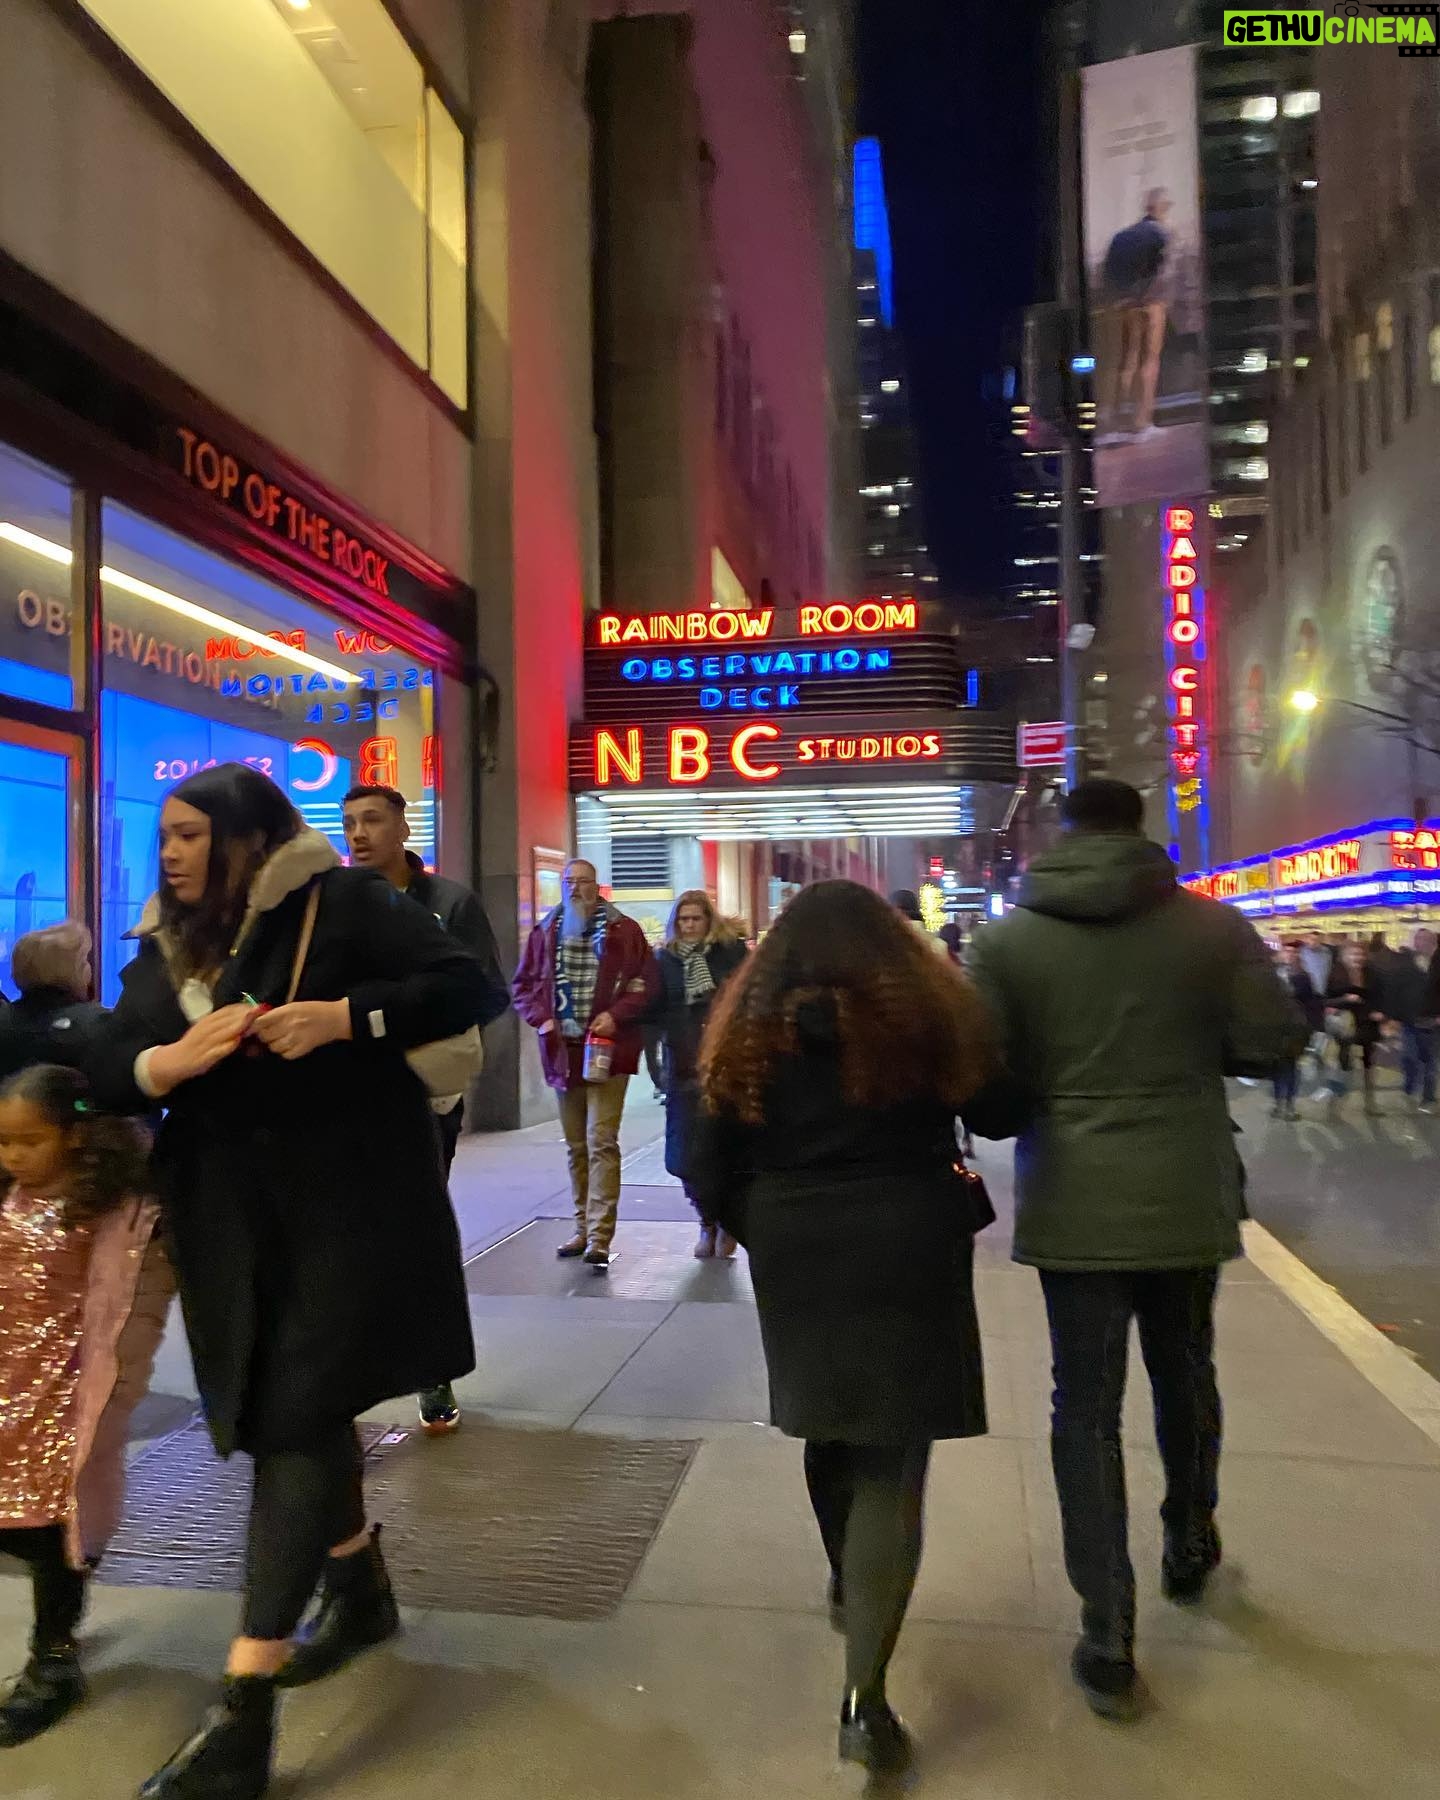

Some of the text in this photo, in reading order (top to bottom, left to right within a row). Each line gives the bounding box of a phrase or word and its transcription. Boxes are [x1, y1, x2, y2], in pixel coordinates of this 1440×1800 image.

[177, 428, 389, 596] TOP OF THE ROCK
[1166, 508, 1199, 643] RADIO
[599, 602, 917, 645] RAINBOW ROOM
[621, 647, 892, 681] OBSERVATION
[699, 684, 801, 710] DECK
[595, 722, 941, 786] NBC STUDIOS
